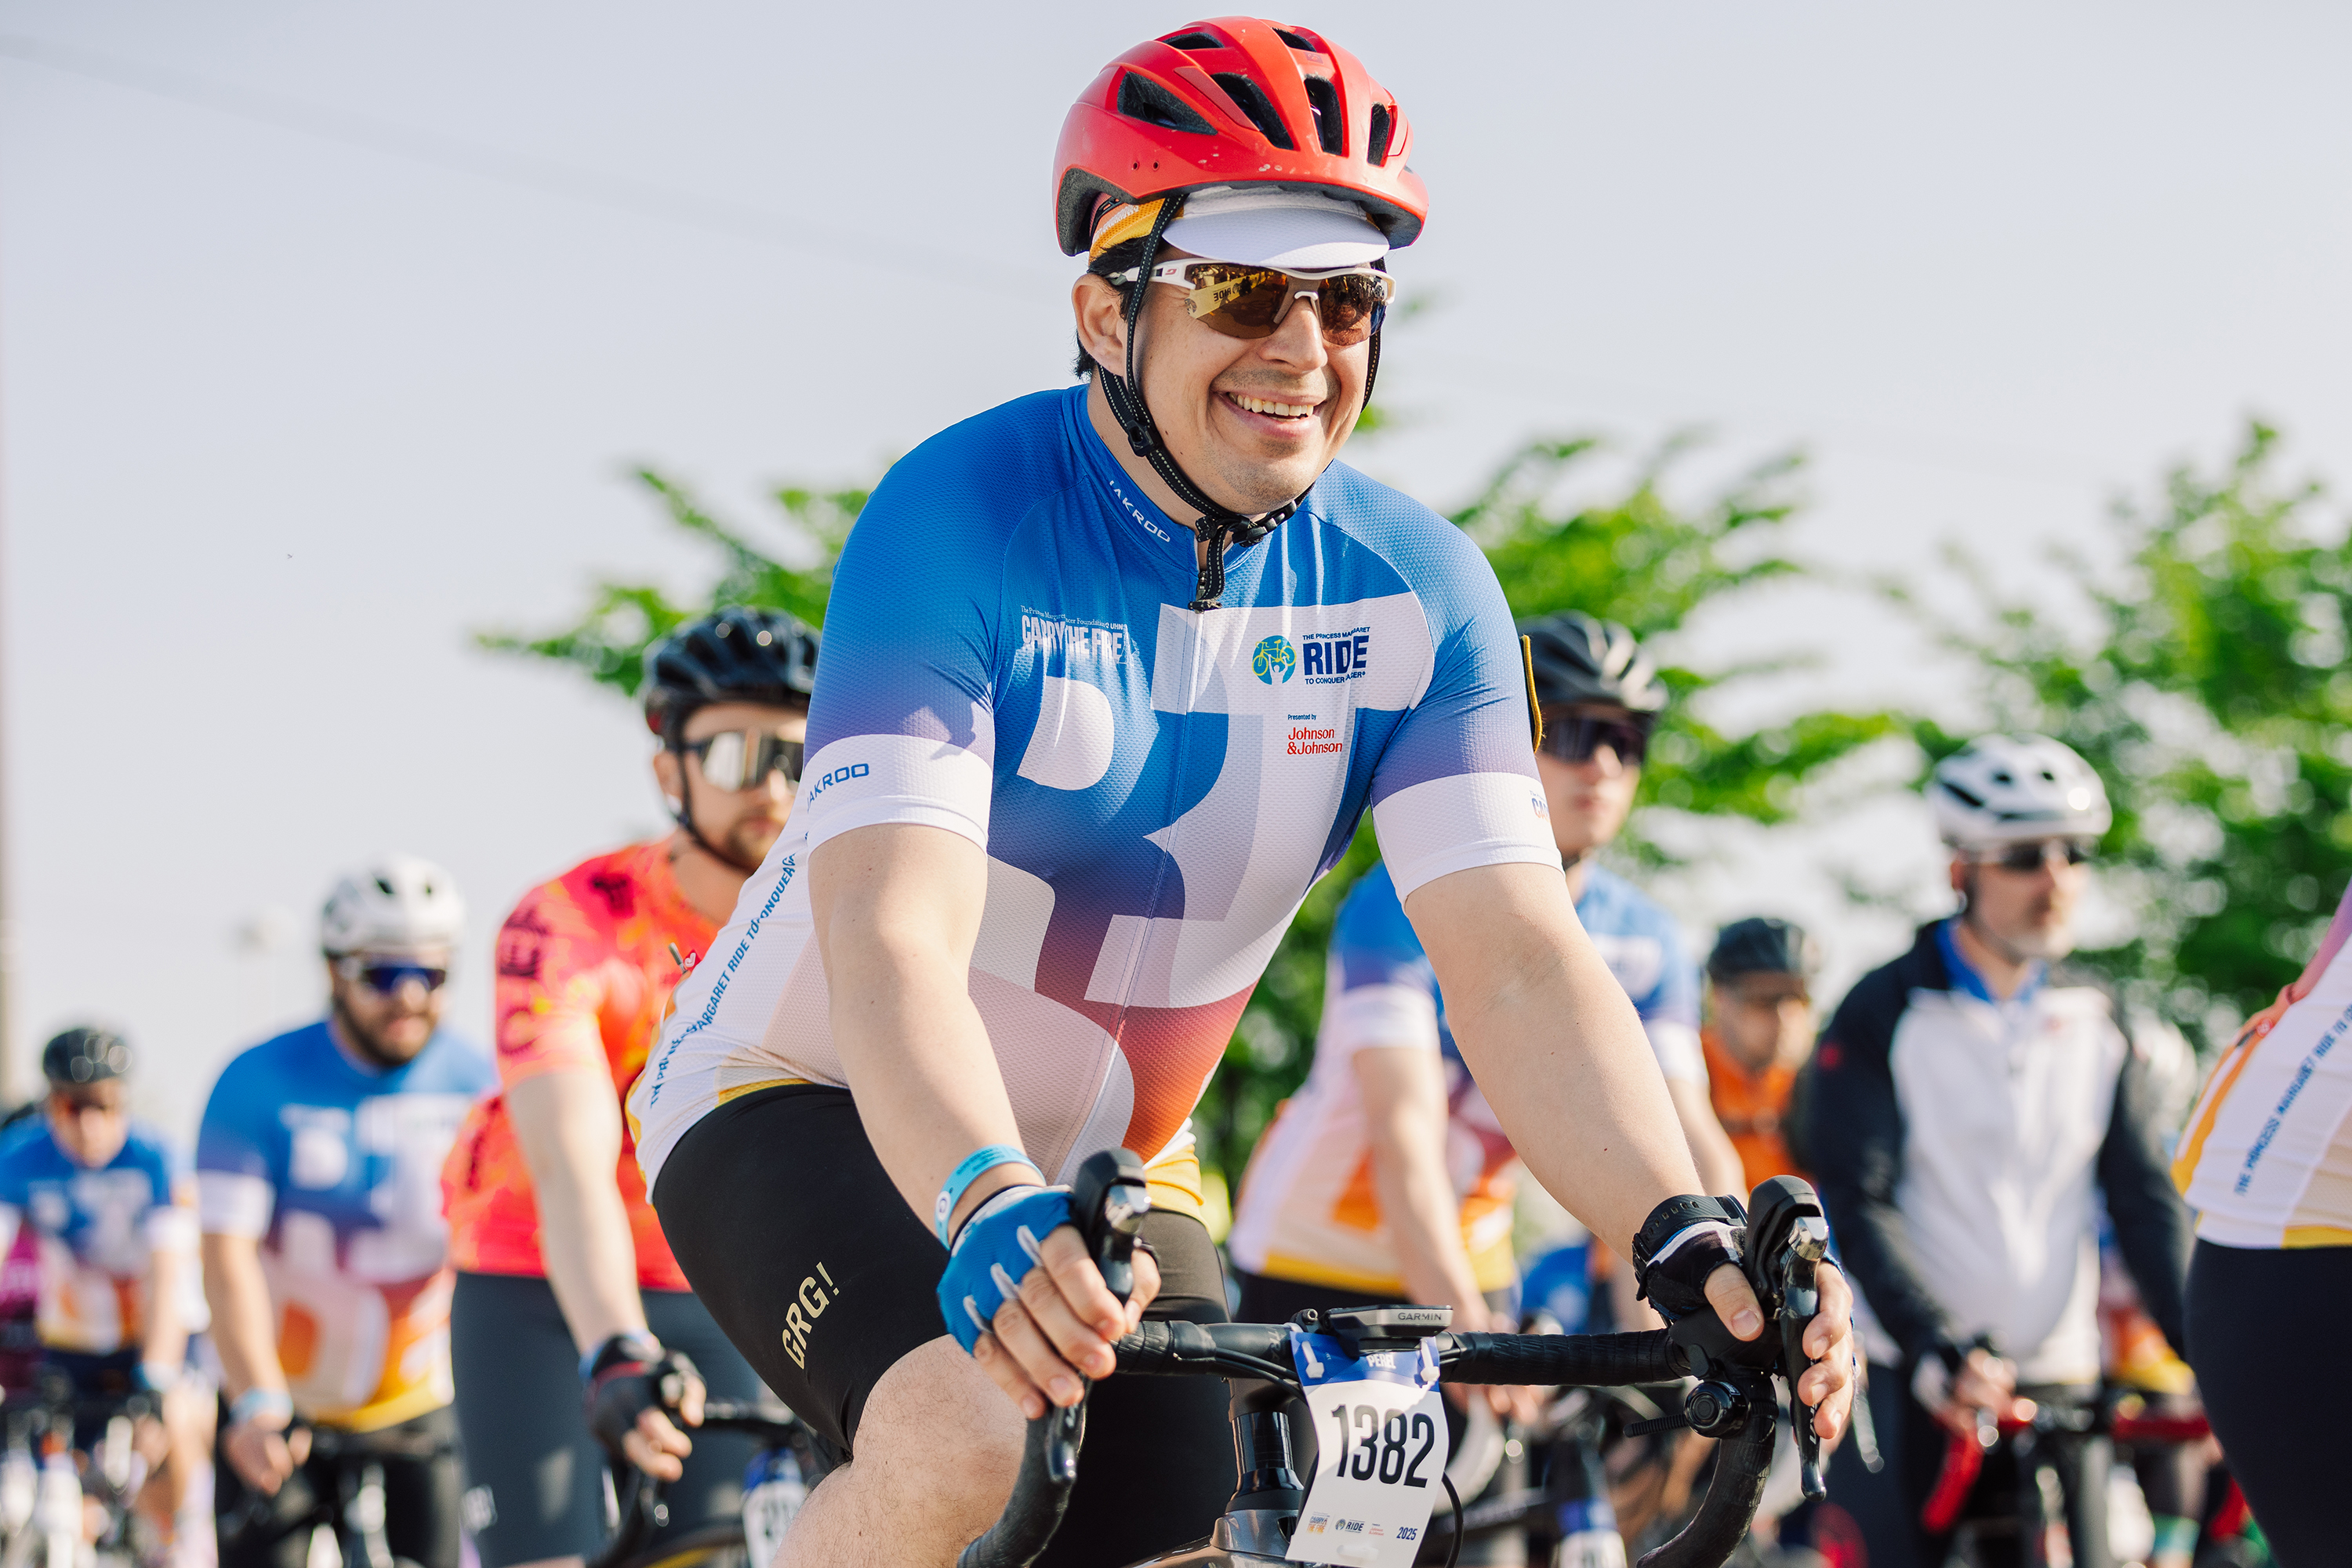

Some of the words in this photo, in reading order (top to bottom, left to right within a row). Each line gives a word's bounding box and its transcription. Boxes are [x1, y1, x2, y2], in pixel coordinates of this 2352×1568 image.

[1029, 607, 1044, 617] Priess
[1066, 626, 1090, 659] HE
[1303, 635, 1369, 676] RIDE
[1288, 727, 1334, 740] Johnson
[1287, 741, 1342, 754] &Johnson
[808, 764, 869, 814] JAKROO
[657, 1025, 697, 1080] PRINCES
[696, 970, 731, 1031] ARGARET
[728, 938, 750, 972] RIDE
[746, 917, 759, 940] TO
[757, 866, 796, 924] ONQUE
[782, 1261, 840, 1370] GRG!
[1398, 1312, 1442, 1321] GARMIN
[1330, 1403, 1435, 1488] 1382
[1345, 1521, 1364, 1531] RIDE
[1396, 1526, 1418, 1541] 2025
